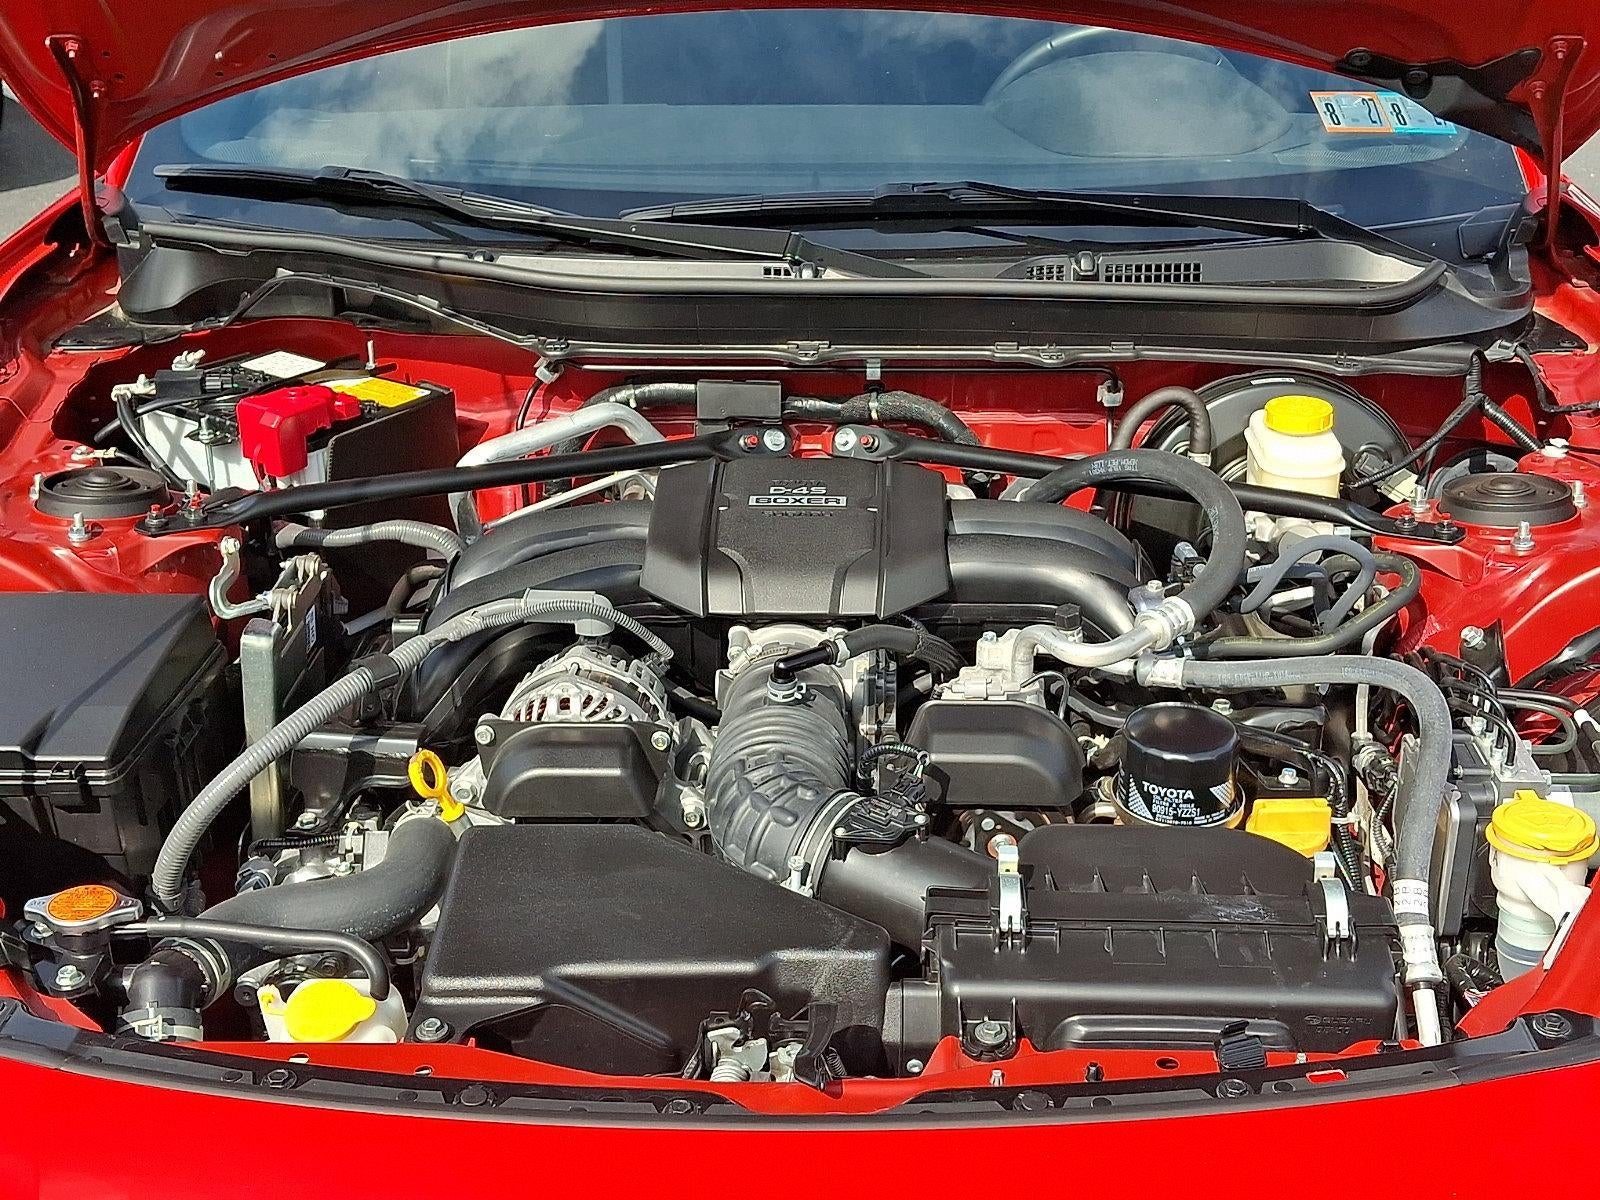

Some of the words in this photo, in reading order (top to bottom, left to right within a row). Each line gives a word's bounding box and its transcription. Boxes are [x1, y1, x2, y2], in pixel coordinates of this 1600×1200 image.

[1324, 102, 1341, 126] 8
[1361, 97, 1383, 127] 27
[1390, 102, 1408, 126] 8
[769, 486, 827, 495] D-4S
[755, 497, 841, 505] BOXER
[1141, 780, 1195, 800] TOYOTA
